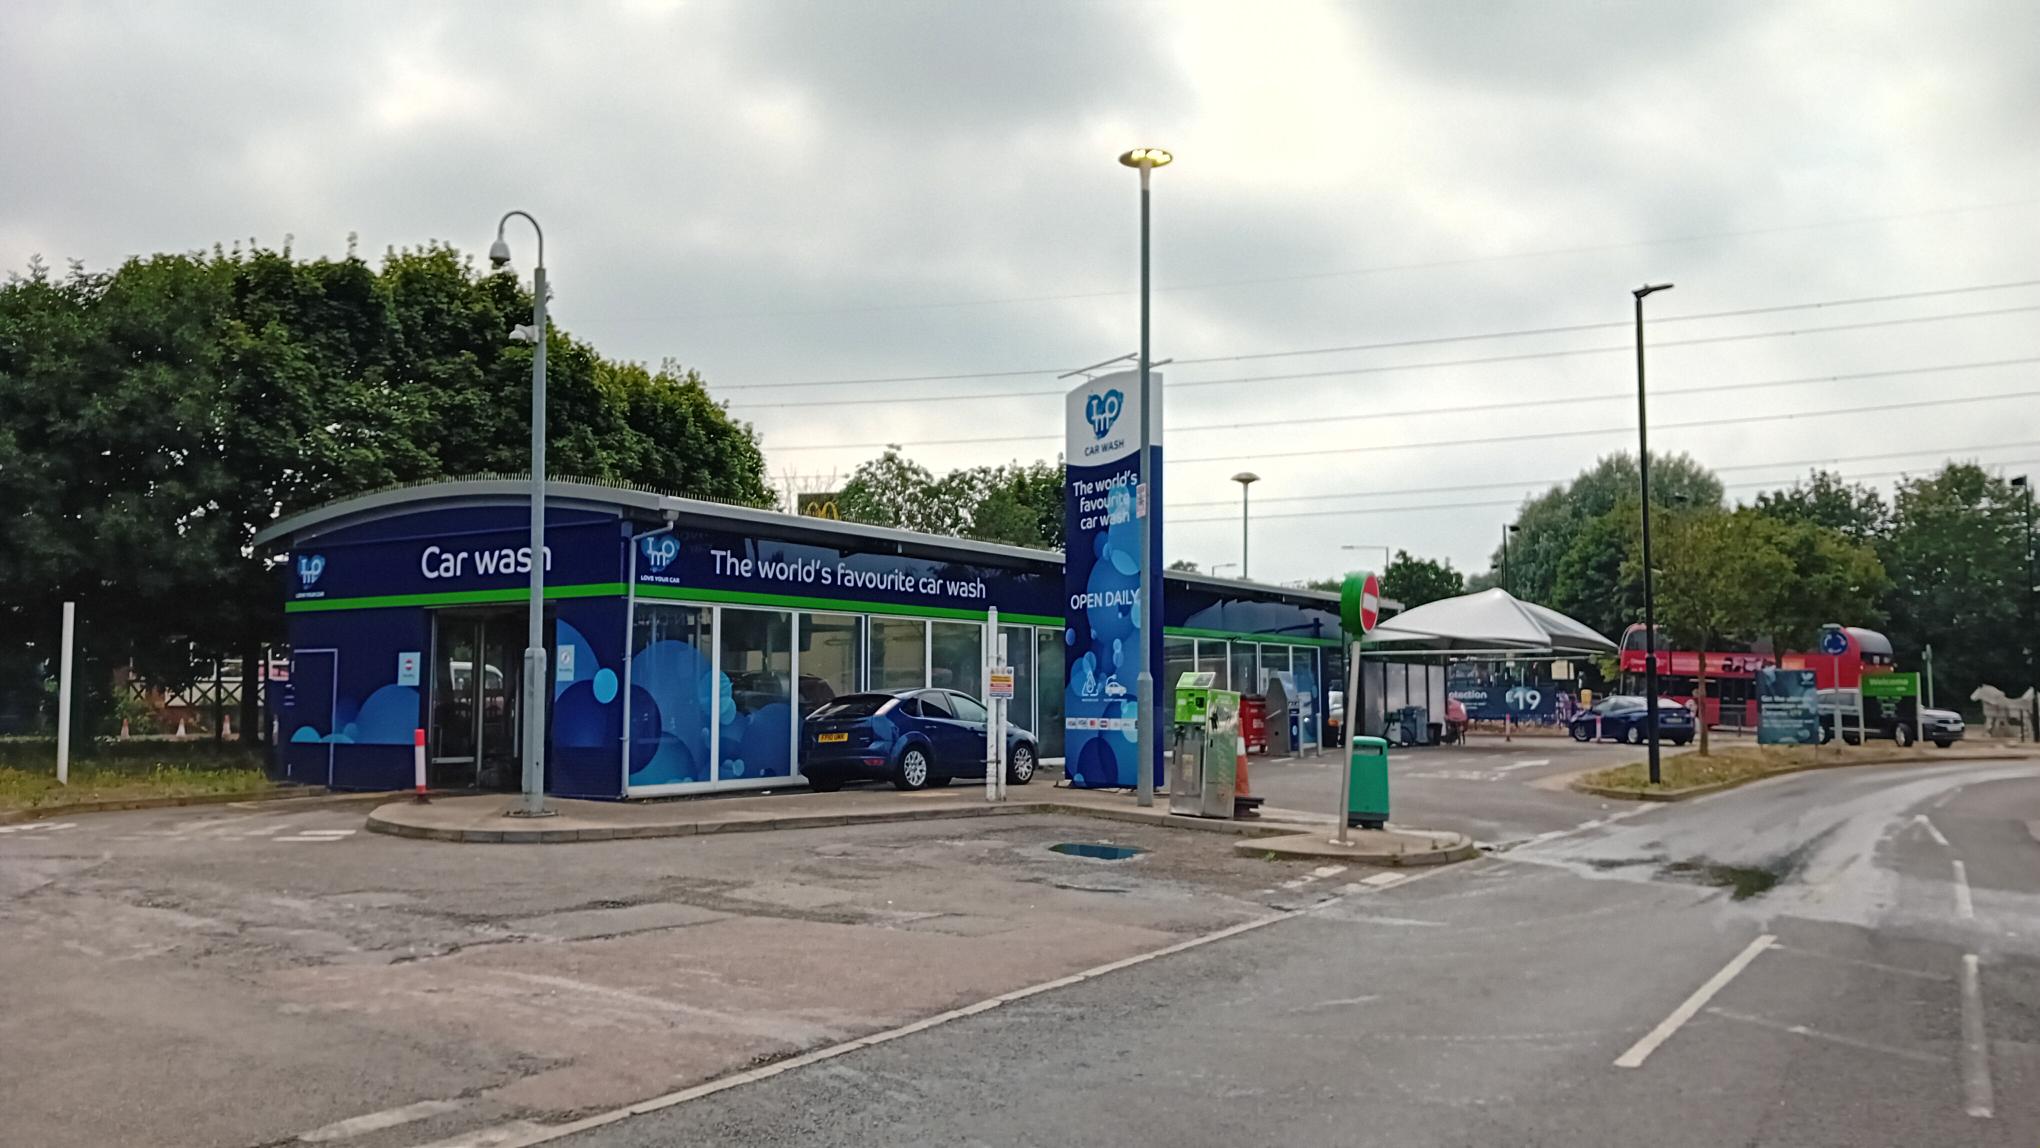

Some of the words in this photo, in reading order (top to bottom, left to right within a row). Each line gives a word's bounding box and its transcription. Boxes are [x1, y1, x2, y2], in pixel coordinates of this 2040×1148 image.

[1084, 445, 1100, 457] CAR
[1101, 439, 1125, 454] WASH
[1073, 480, 1094, 497] The
[1095, 470, 1138, 490] world's
[1080, 493, 1130, 513] favourite
[1080, 516, 1098, 530] car
[1100, 511, 1130, 526] wash
[421, 545, 469, 579] Car
[710, 549, 752, 578] The
[757, 557, 832, 585] world's
[836, 562, 915, 594] favourite
[918, 575, 944, 595] car
[946, 577, 987, 599] wash
[1070, 593, 1103, 610] OPEN
[1105, 590, 1138, 607] DAILY
[1868, 678, 1909, 686] Welcome
